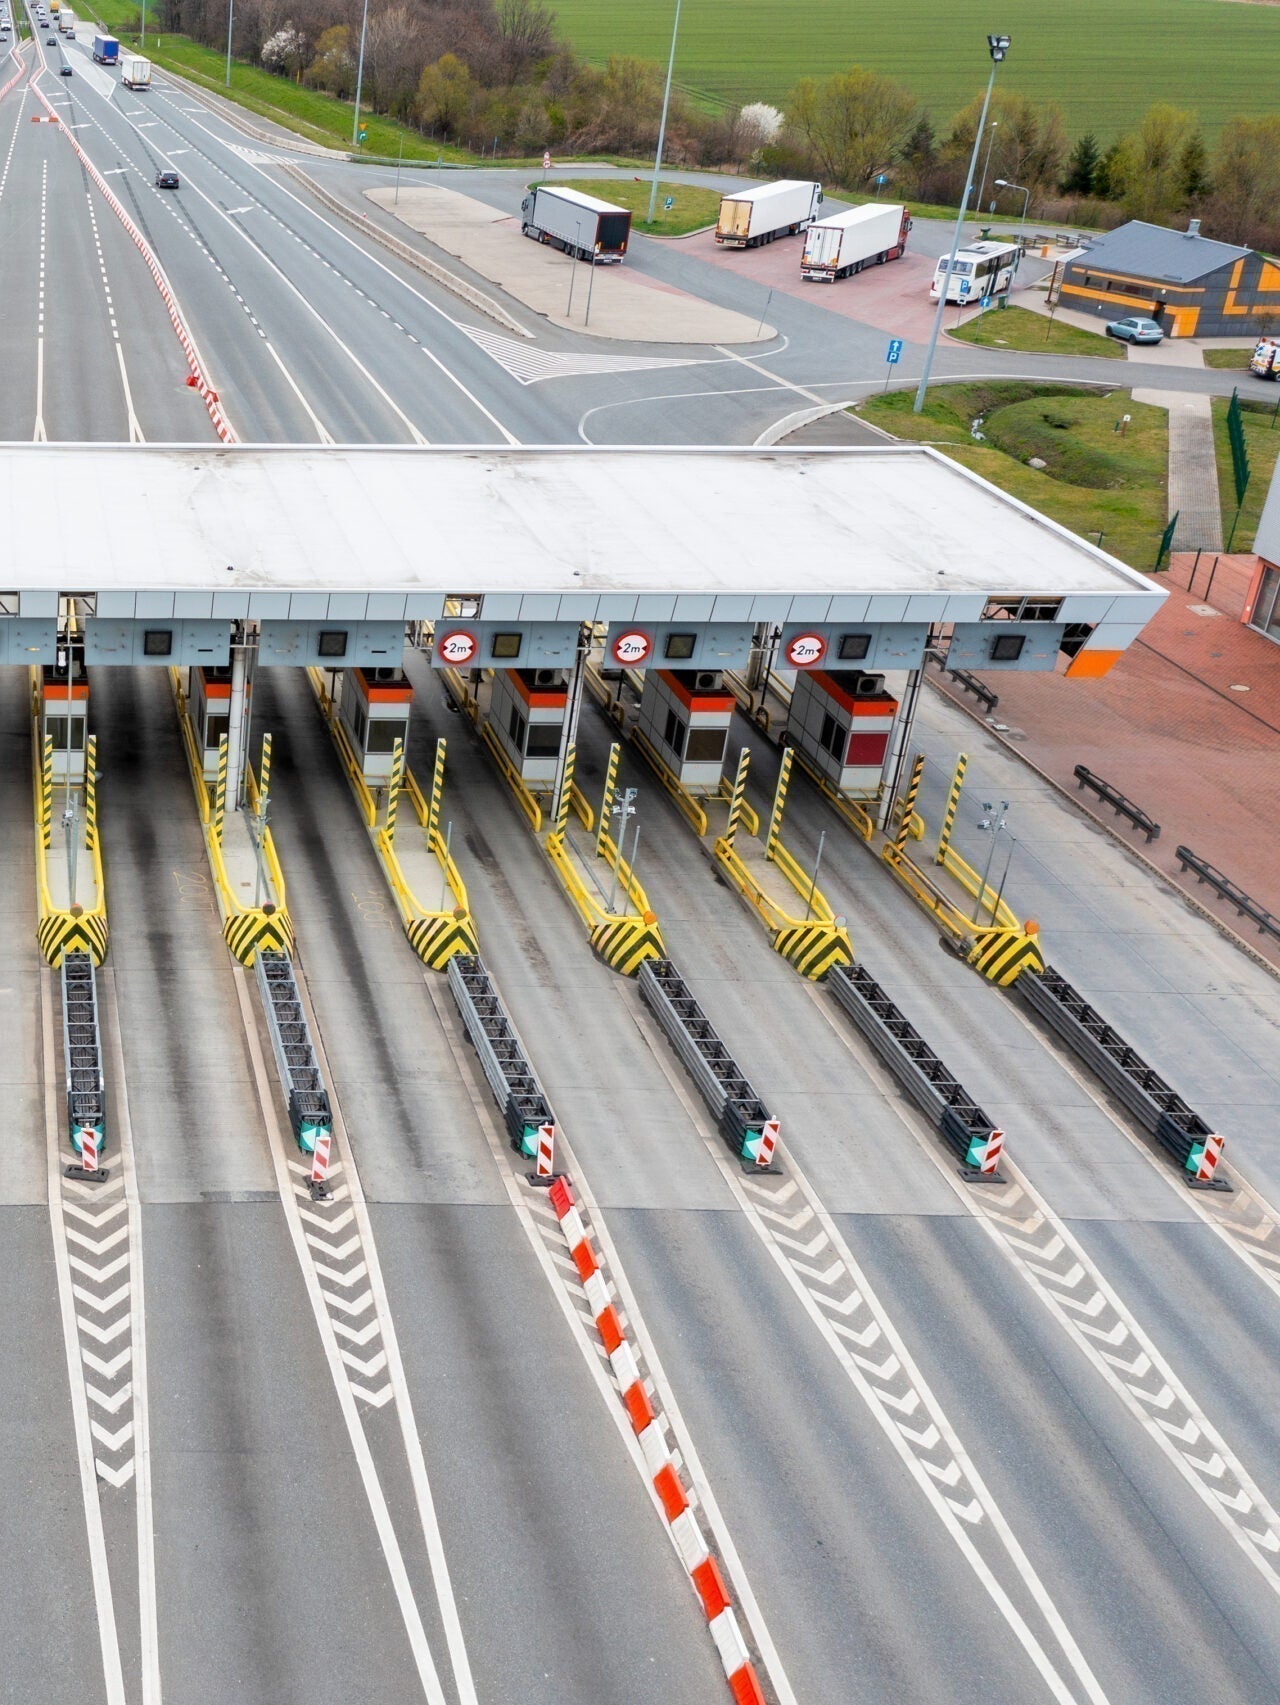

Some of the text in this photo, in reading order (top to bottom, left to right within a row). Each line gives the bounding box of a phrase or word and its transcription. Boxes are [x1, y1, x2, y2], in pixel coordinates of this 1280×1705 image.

[889, 352, 897, 361] P
[449, 642, 467, 653] 2m
[623, 642, 641, 653] 2m
[797, 645, 815, 656] 2m
